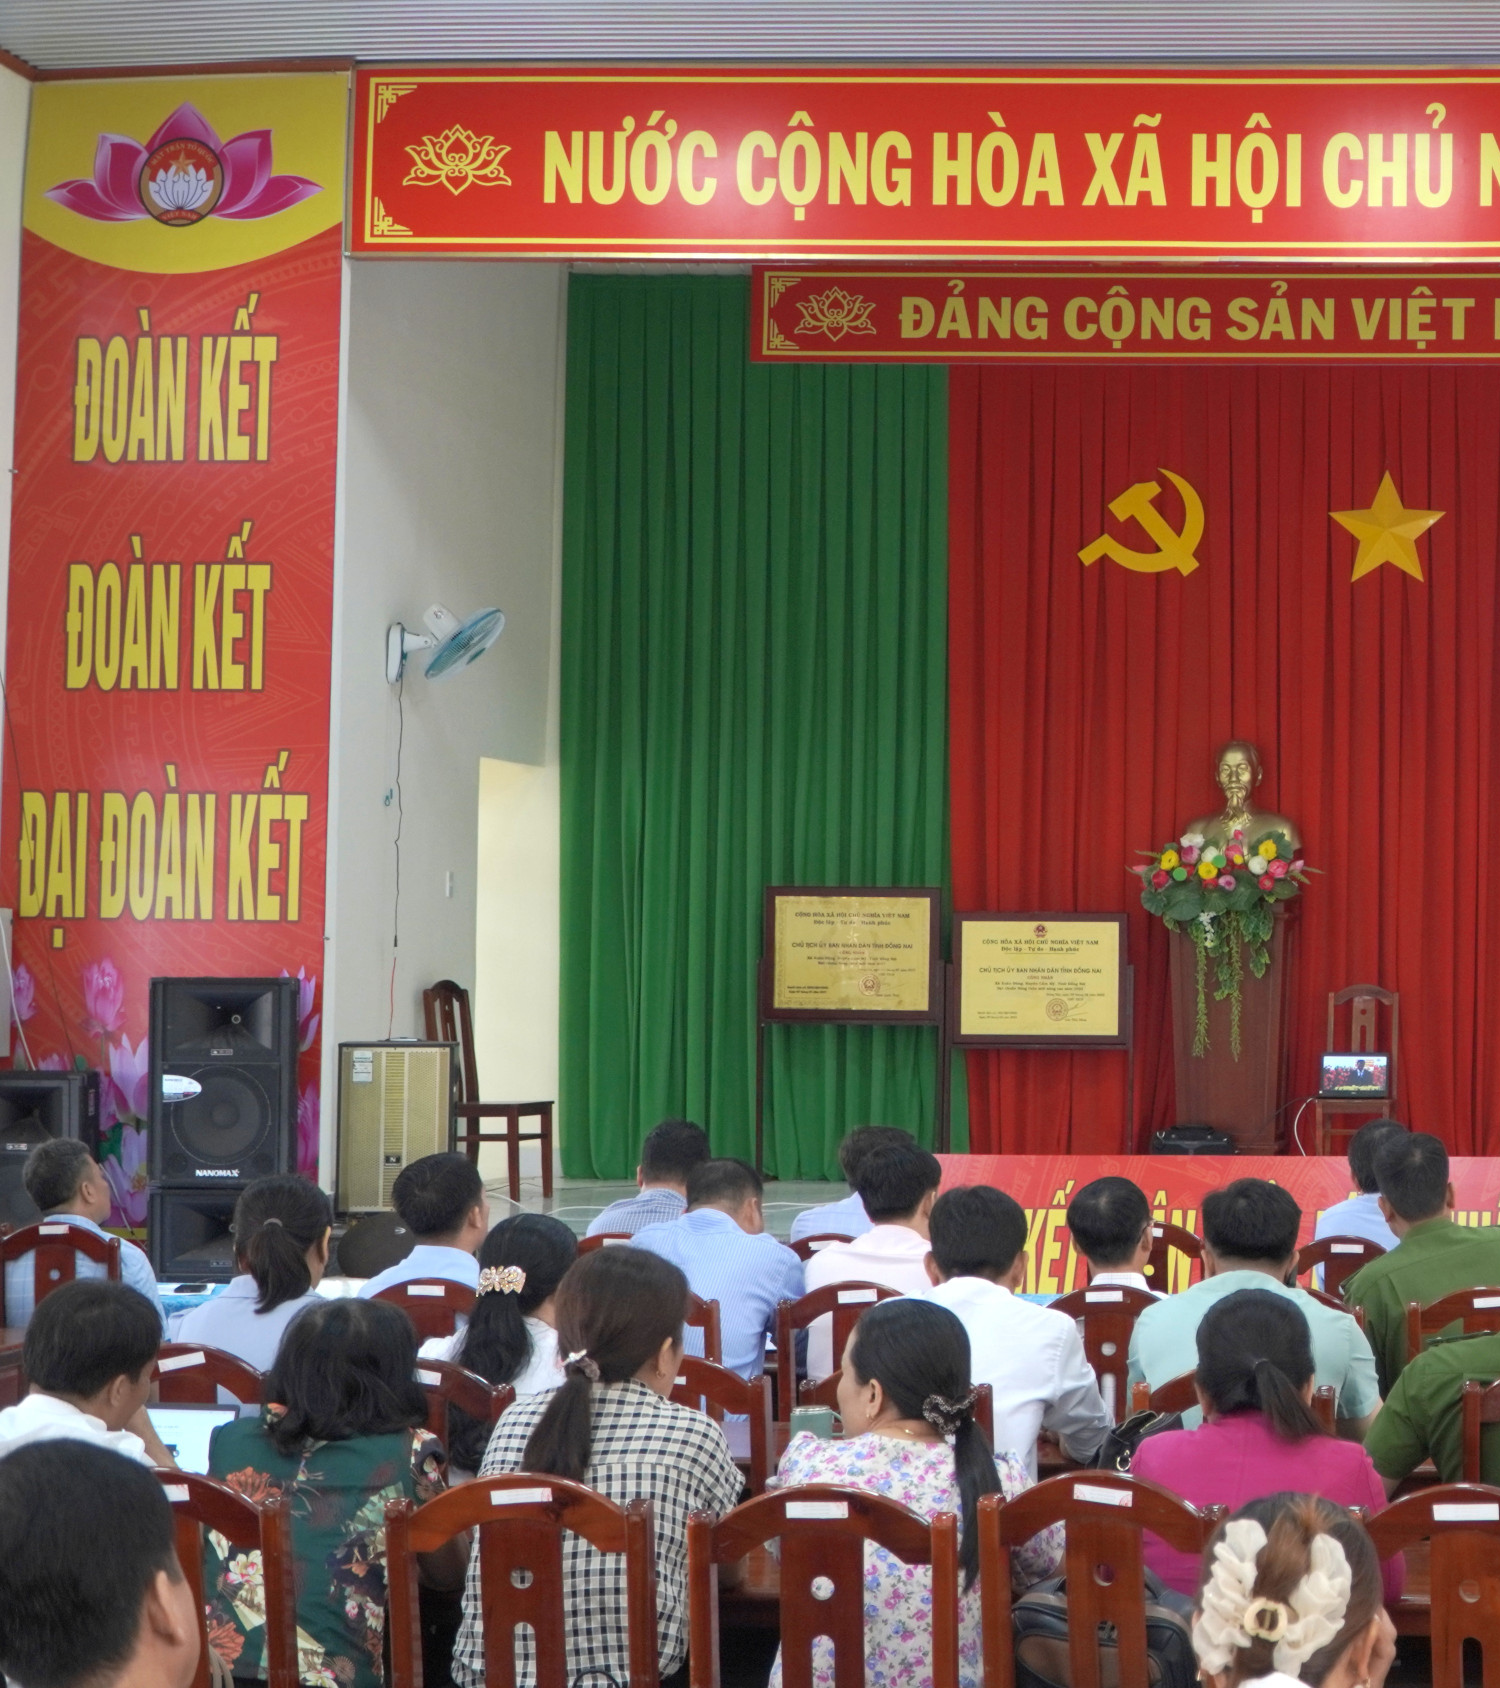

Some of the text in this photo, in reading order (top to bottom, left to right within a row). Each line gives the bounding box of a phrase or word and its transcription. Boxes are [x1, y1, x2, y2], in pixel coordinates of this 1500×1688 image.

[542, 110, 718, 206] NƯỚC
[736, 110, 912, 221] CỘNG
[931, 111, 1065, 208] HÒA
[1081, 113, 1168, 208] XÃ
[1190, 112, 1303, 224] HỘI
[1321, 102, 1454, 209] CHỦ
[74, 293, 278, 463] ĐOÀN KẾT
[899, 280, 1048, 340] ĐẢNG
[1064, 286, 1211, 349] CỘNG
[1226, 281, 1335, 340] SẢN
[1351, 286, 1475, 349] VIỆT
[66, 521, 271, 691] ĐOÀN KẾT
[19, 751, 309, 948] ĐẠI ĐOÀN KẾT
[195, 1169, 238, 1177] NANOMAX
